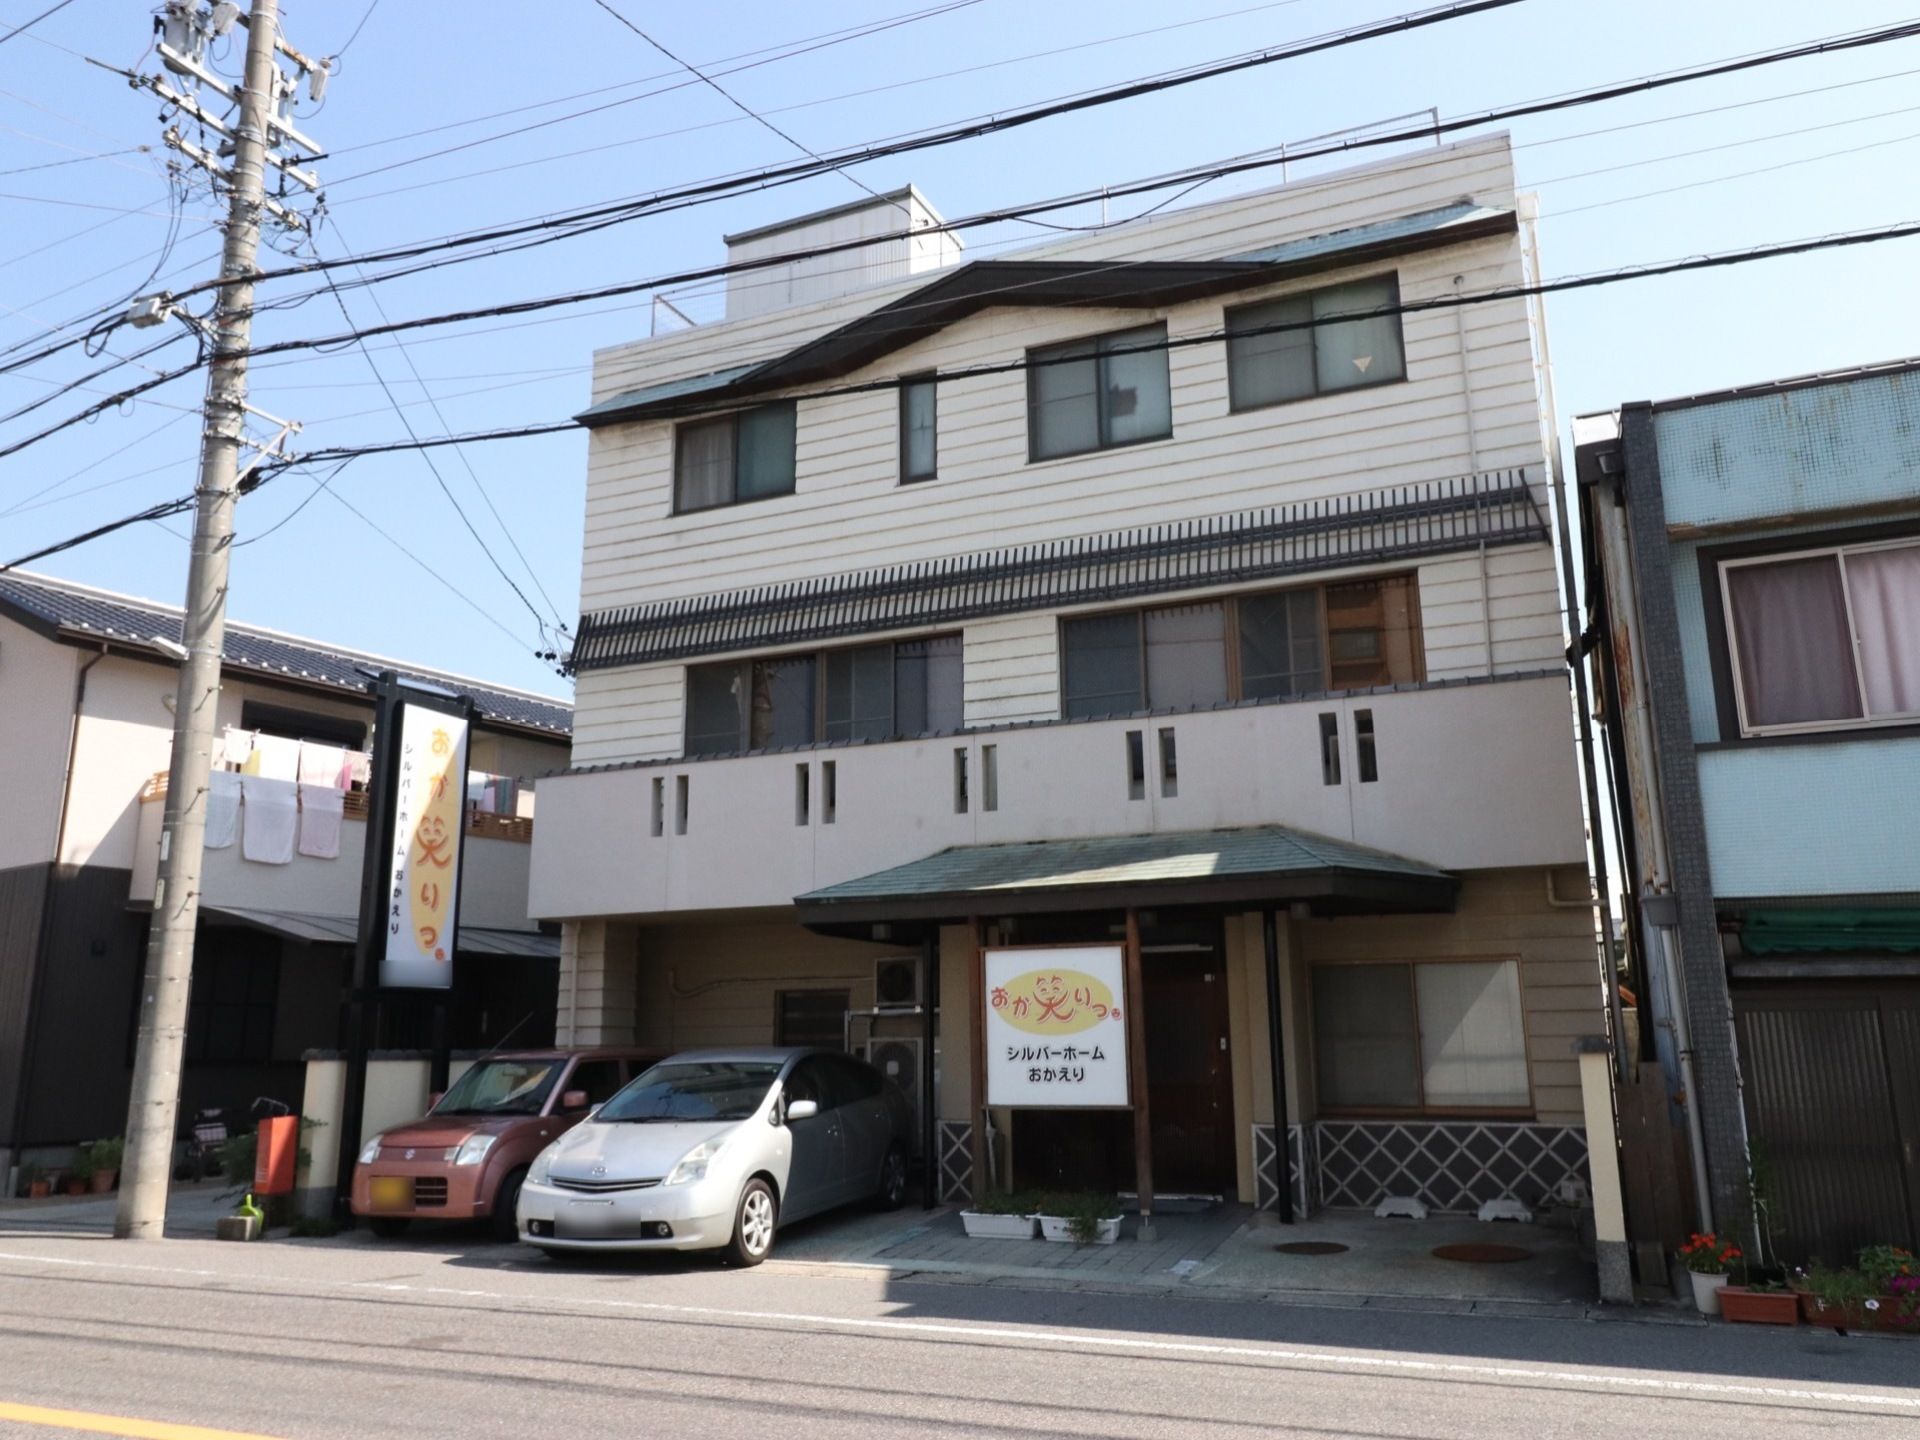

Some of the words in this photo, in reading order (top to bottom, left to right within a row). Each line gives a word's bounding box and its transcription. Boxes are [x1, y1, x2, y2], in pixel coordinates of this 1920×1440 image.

[390, 869, 404, 935] おかえり
[1007, 1045, 1105, 1061] シルバーホーム
[1029, 1067, 1085, 1082] おかえり
